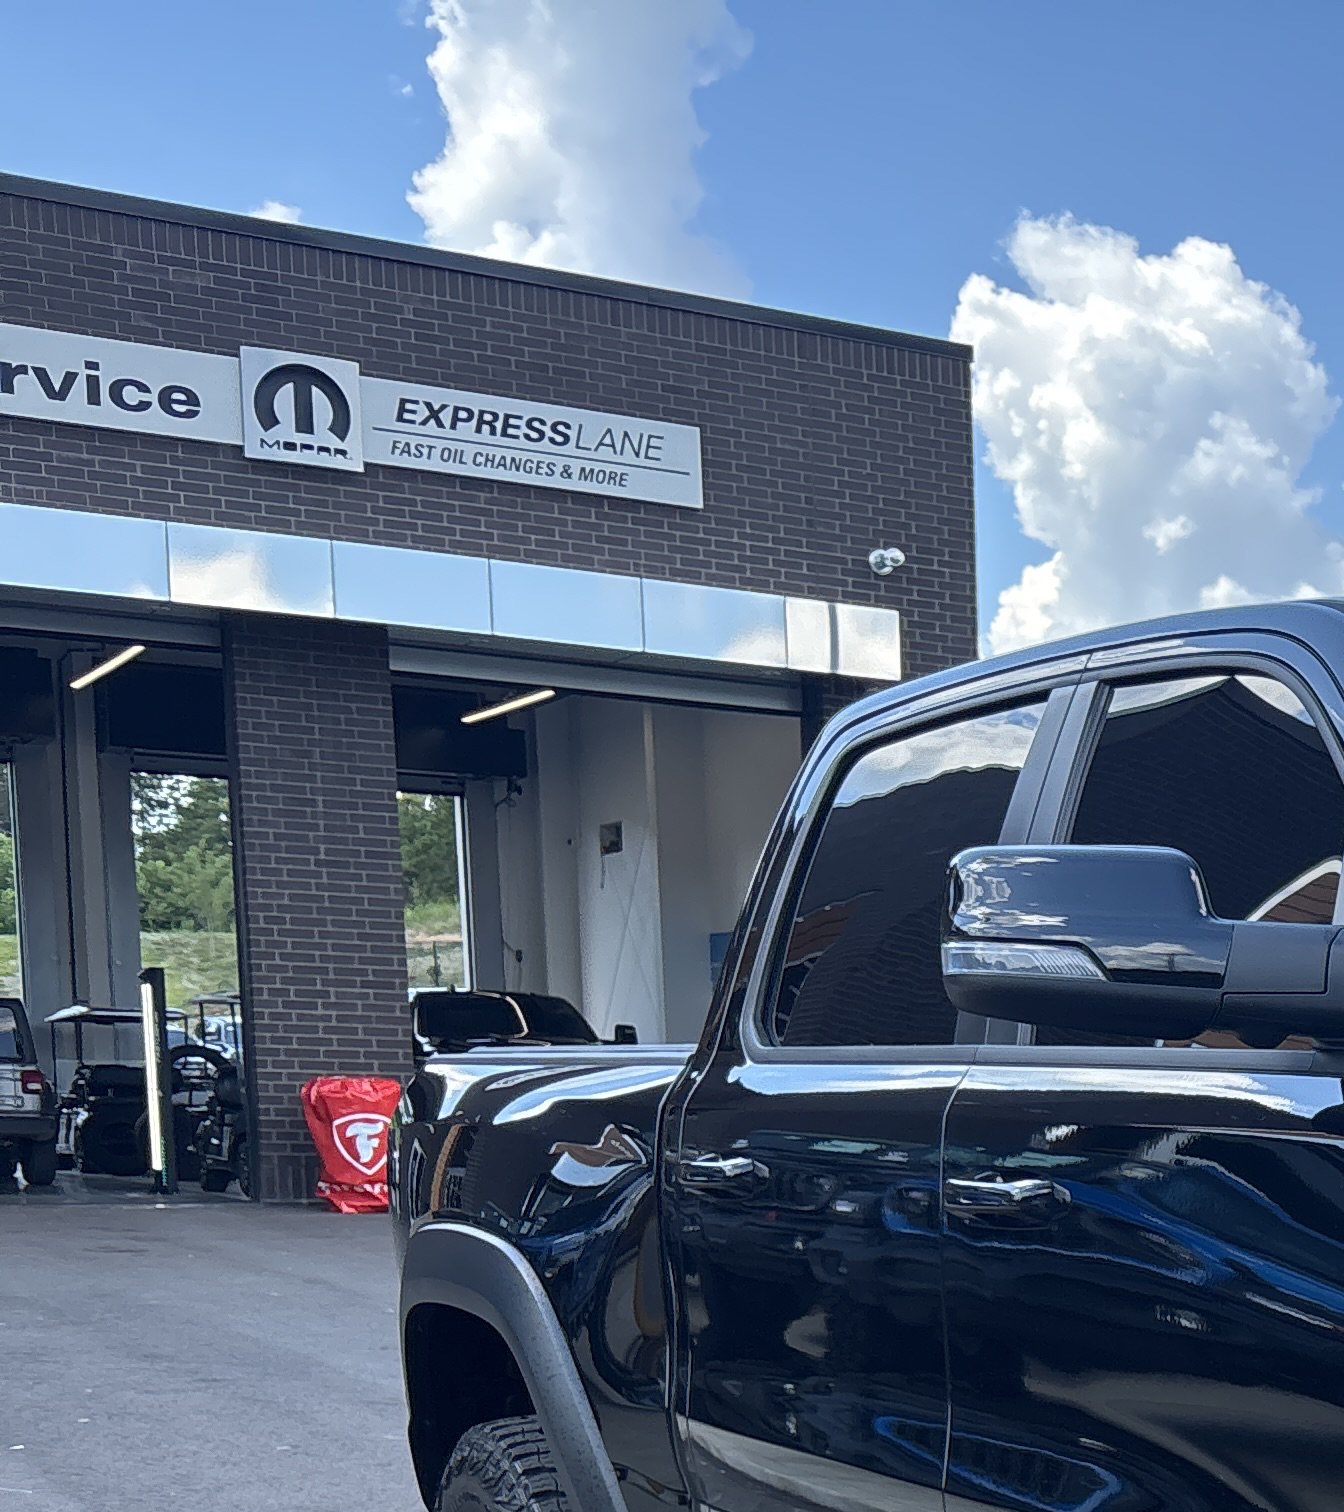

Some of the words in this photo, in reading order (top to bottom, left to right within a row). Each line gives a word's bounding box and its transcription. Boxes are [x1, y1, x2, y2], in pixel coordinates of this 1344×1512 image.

[260, 437, 350, 460] MOPAR
[390, 440, 438, 460] FAST
[440, 446, 468, 466] OIL
[472, 451, 557, 477] CHANGES
[560, 464, 574, 480] &
[577, 467, 630, 488] MORE
